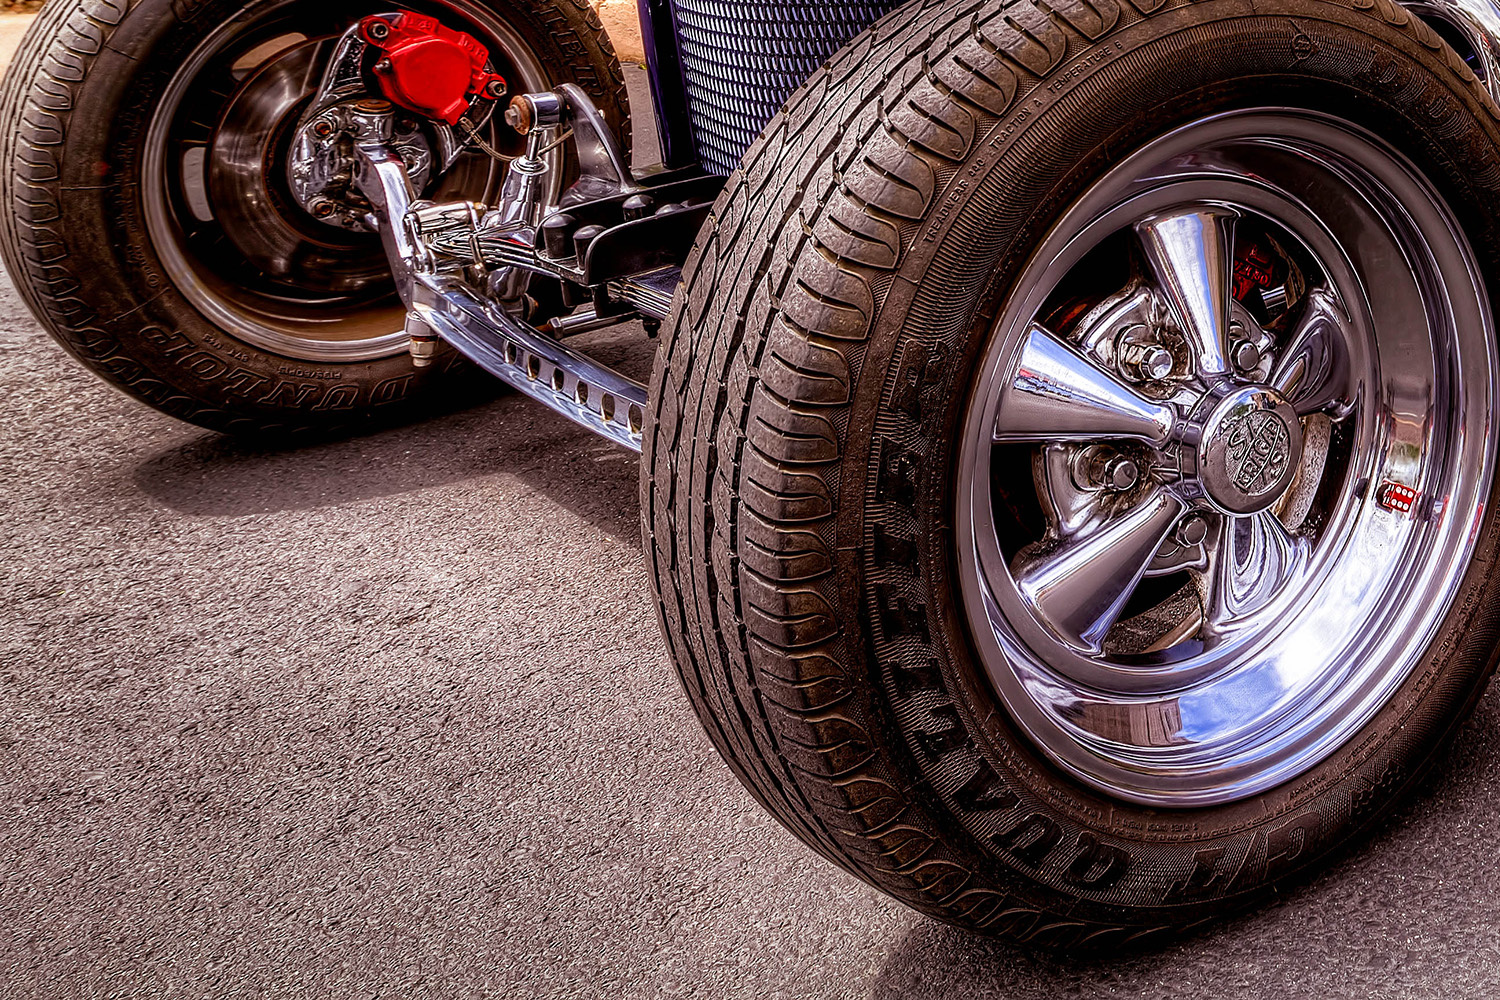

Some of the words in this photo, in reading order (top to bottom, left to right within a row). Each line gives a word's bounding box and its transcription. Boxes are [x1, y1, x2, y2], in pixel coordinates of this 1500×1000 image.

[923, 179, 969, 244] TREADWEAR
[988, 107, 1031, 150] TRACTION
[1033, 98, 1043, 108] A
[1047, 46, 1112, 96] TEMPERATURE
[139, 325, 415, 411] DUNLOP
[1235, 417, 1281, 487] CRAGAR
[871, 340, 1130, 887] QUALIFIER
[1438, 628, 1460, 653] MADE
[1429, 655, 1440, 670] IN
